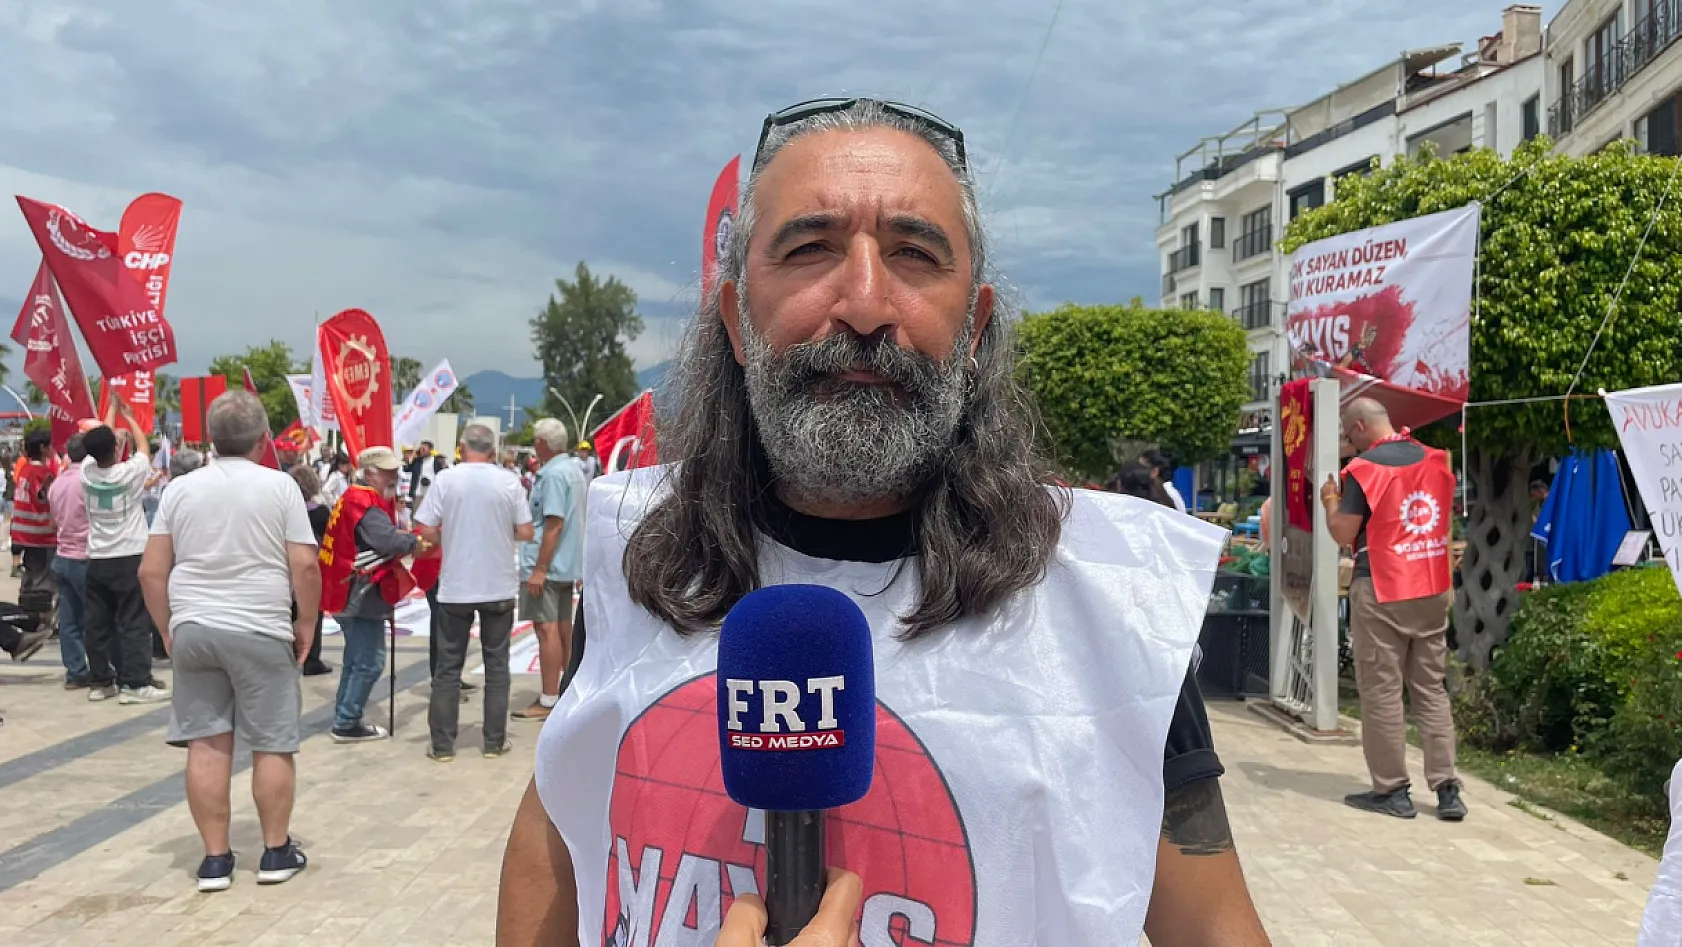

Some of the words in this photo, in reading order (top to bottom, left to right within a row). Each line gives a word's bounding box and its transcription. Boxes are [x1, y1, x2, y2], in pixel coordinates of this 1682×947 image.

[124, 252, 170, 270] CHP
[1306, 249, 1349, 275] SAYAN
[1351, 237, 1408, 266] DÜZEN,
[1306, 265, 1385, 297] KURAMAZ
[726, 675, 845, 733] FRT
[731, 735, 764, 748] SED
[767, 733, 840, 749] MEDYA
